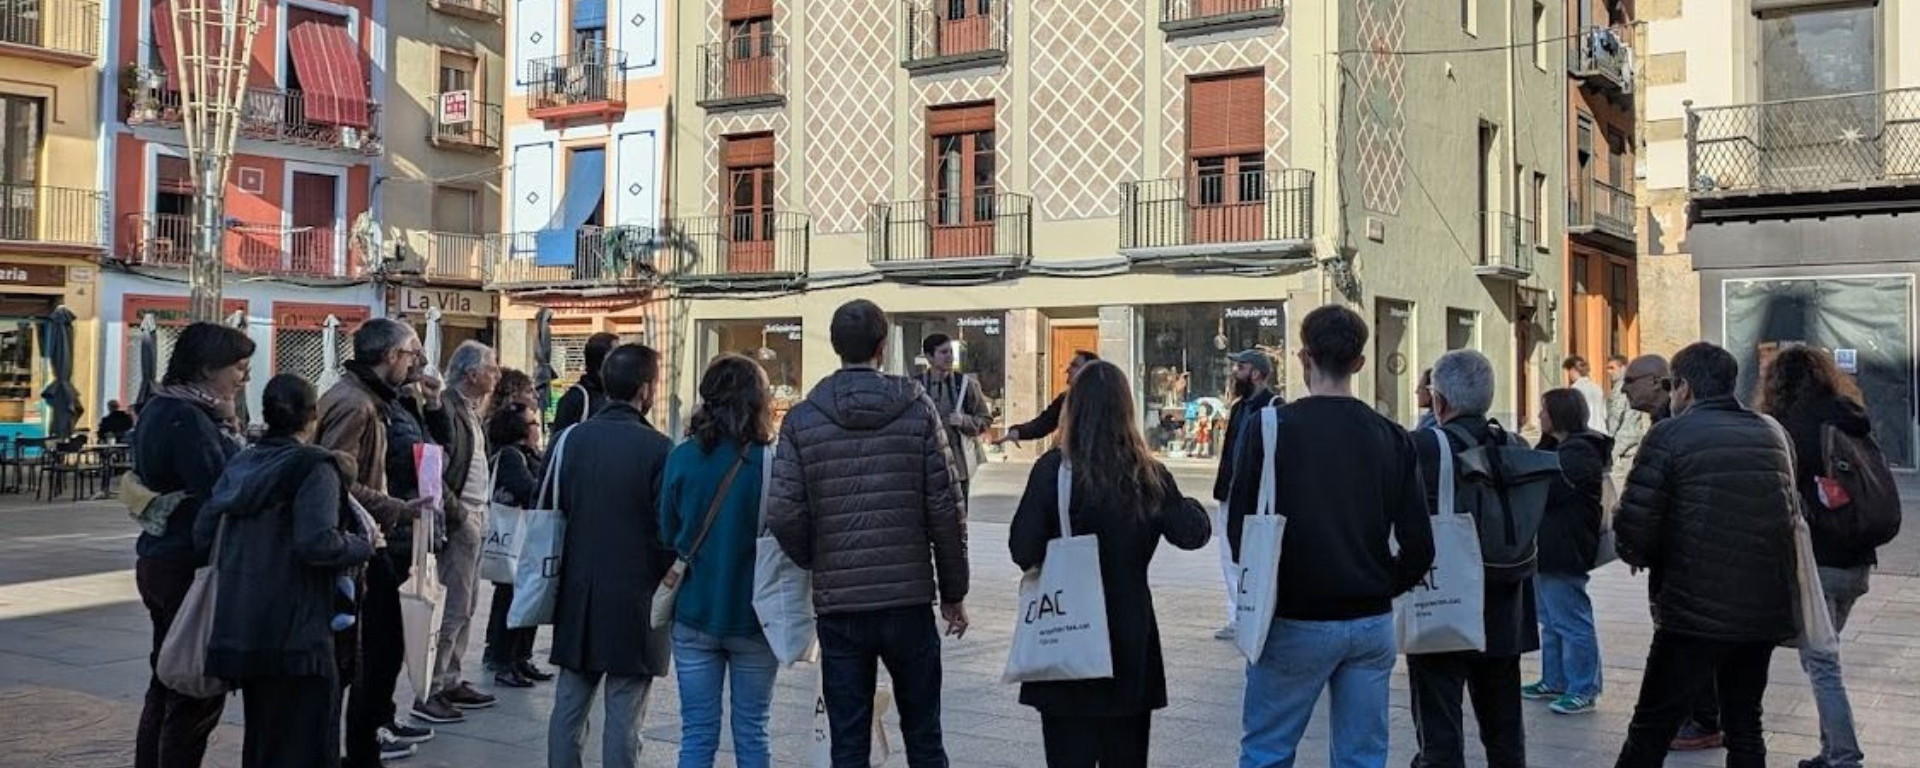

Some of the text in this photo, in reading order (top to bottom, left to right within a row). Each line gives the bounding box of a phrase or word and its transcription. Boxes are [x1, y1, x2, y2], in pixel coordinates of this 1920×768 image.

[408, 290, 429, 309] La
[437, 291, 471, 312] Vila
[486, 531, 511, 547] AC
